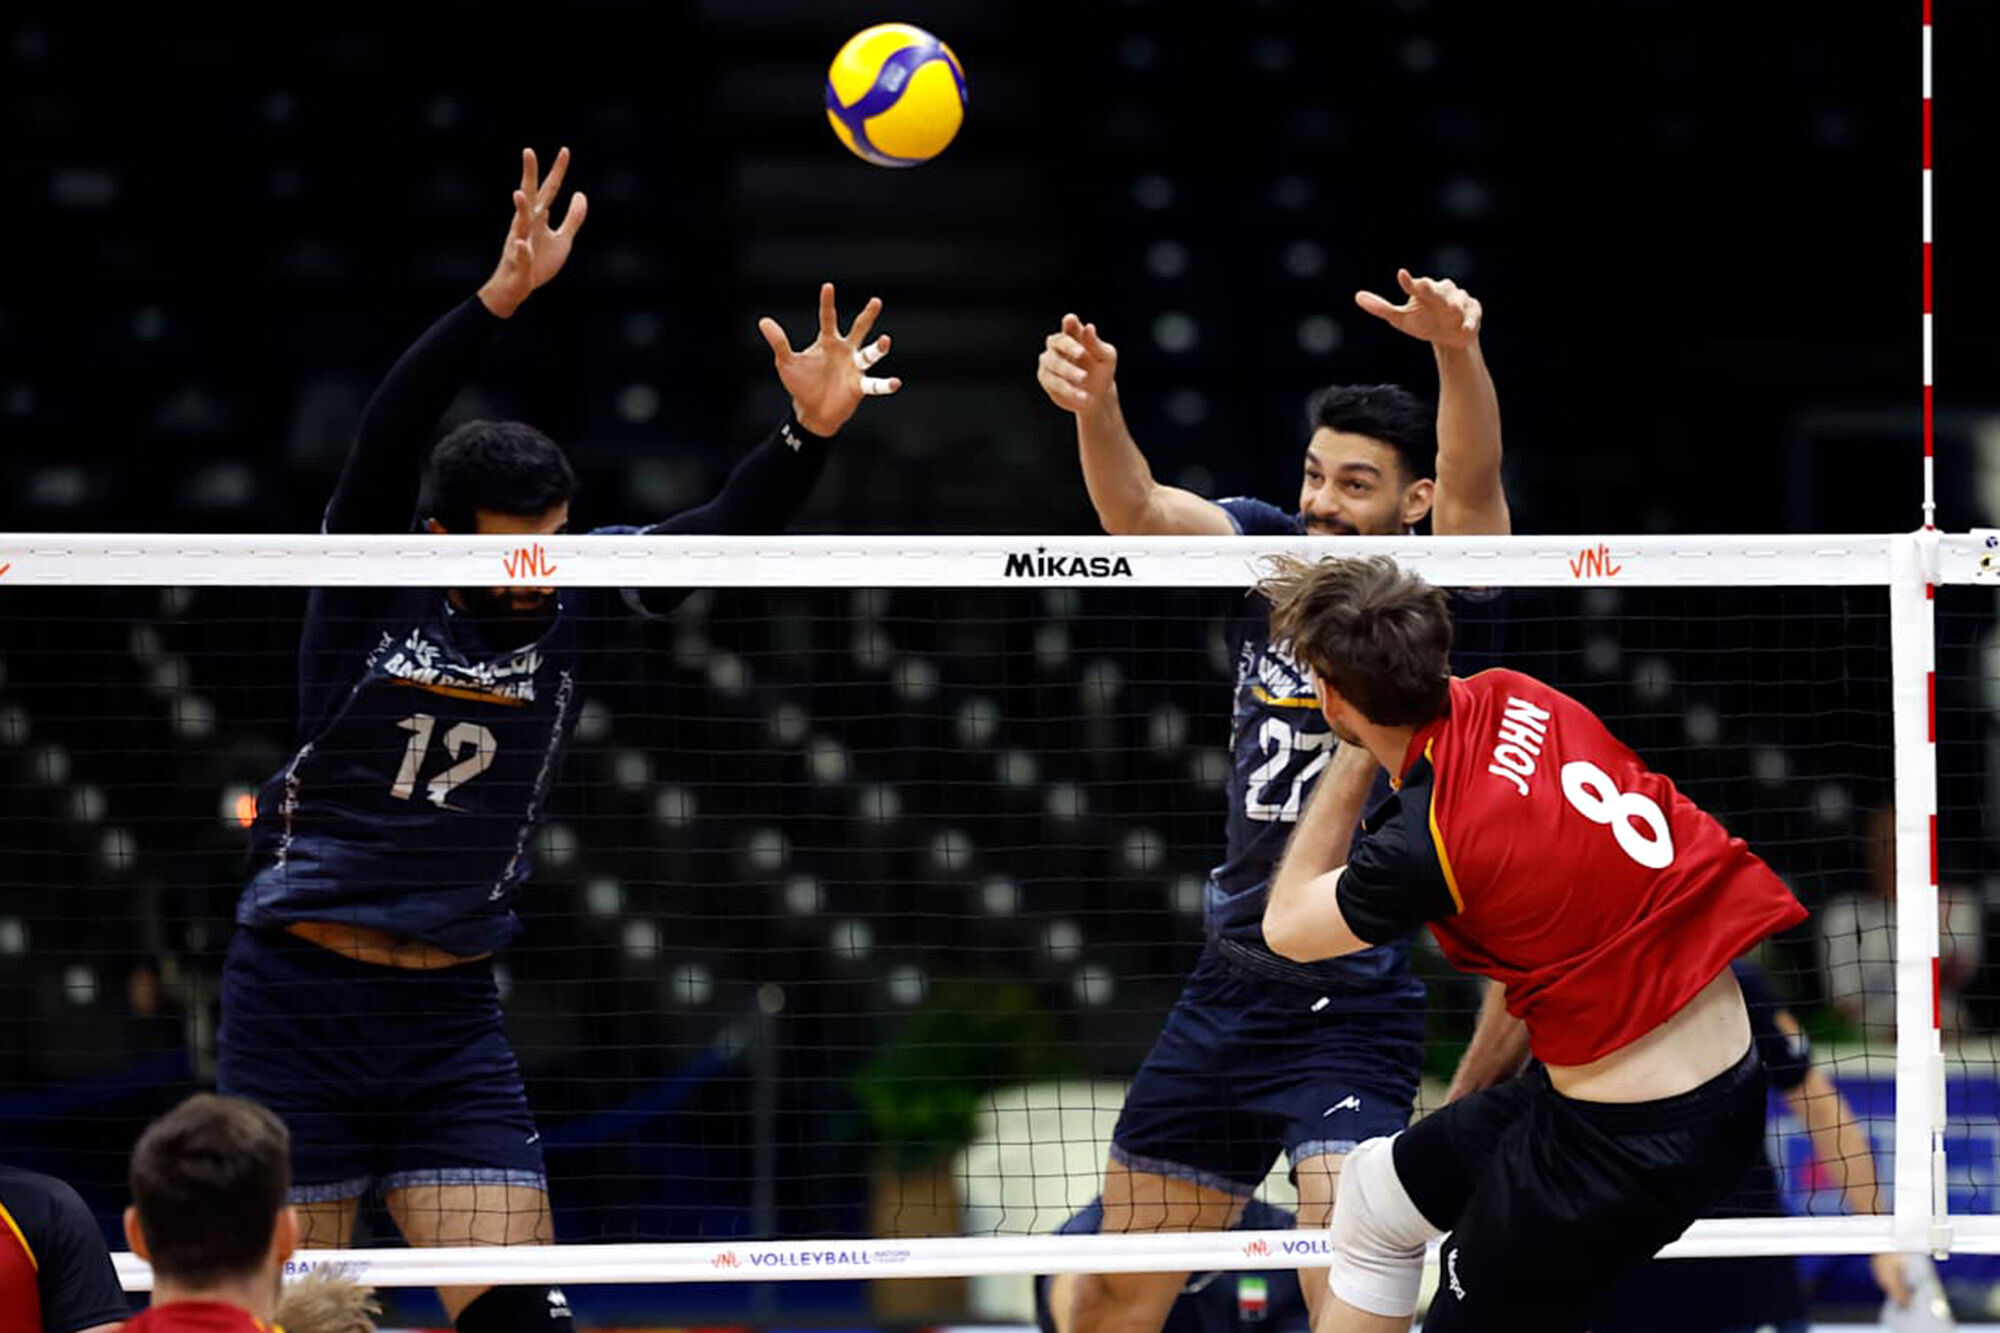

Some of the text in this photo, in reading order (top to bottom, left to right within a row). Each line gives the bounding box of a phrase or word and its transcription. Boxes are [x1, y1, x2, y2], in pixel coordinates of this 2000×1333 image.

[503, 542, 557, 578] VNL
[1568, 543, 1621, 578] VNL
[388, 712, 499, 812] 12
[1488, 696, 1550, 796] JOHN
[1561, 761, 1675, 869] 8
[750, 1250, 870, 1266] VOLLEYBALL
[1283, 1240, 1334, 1255] VOLL
